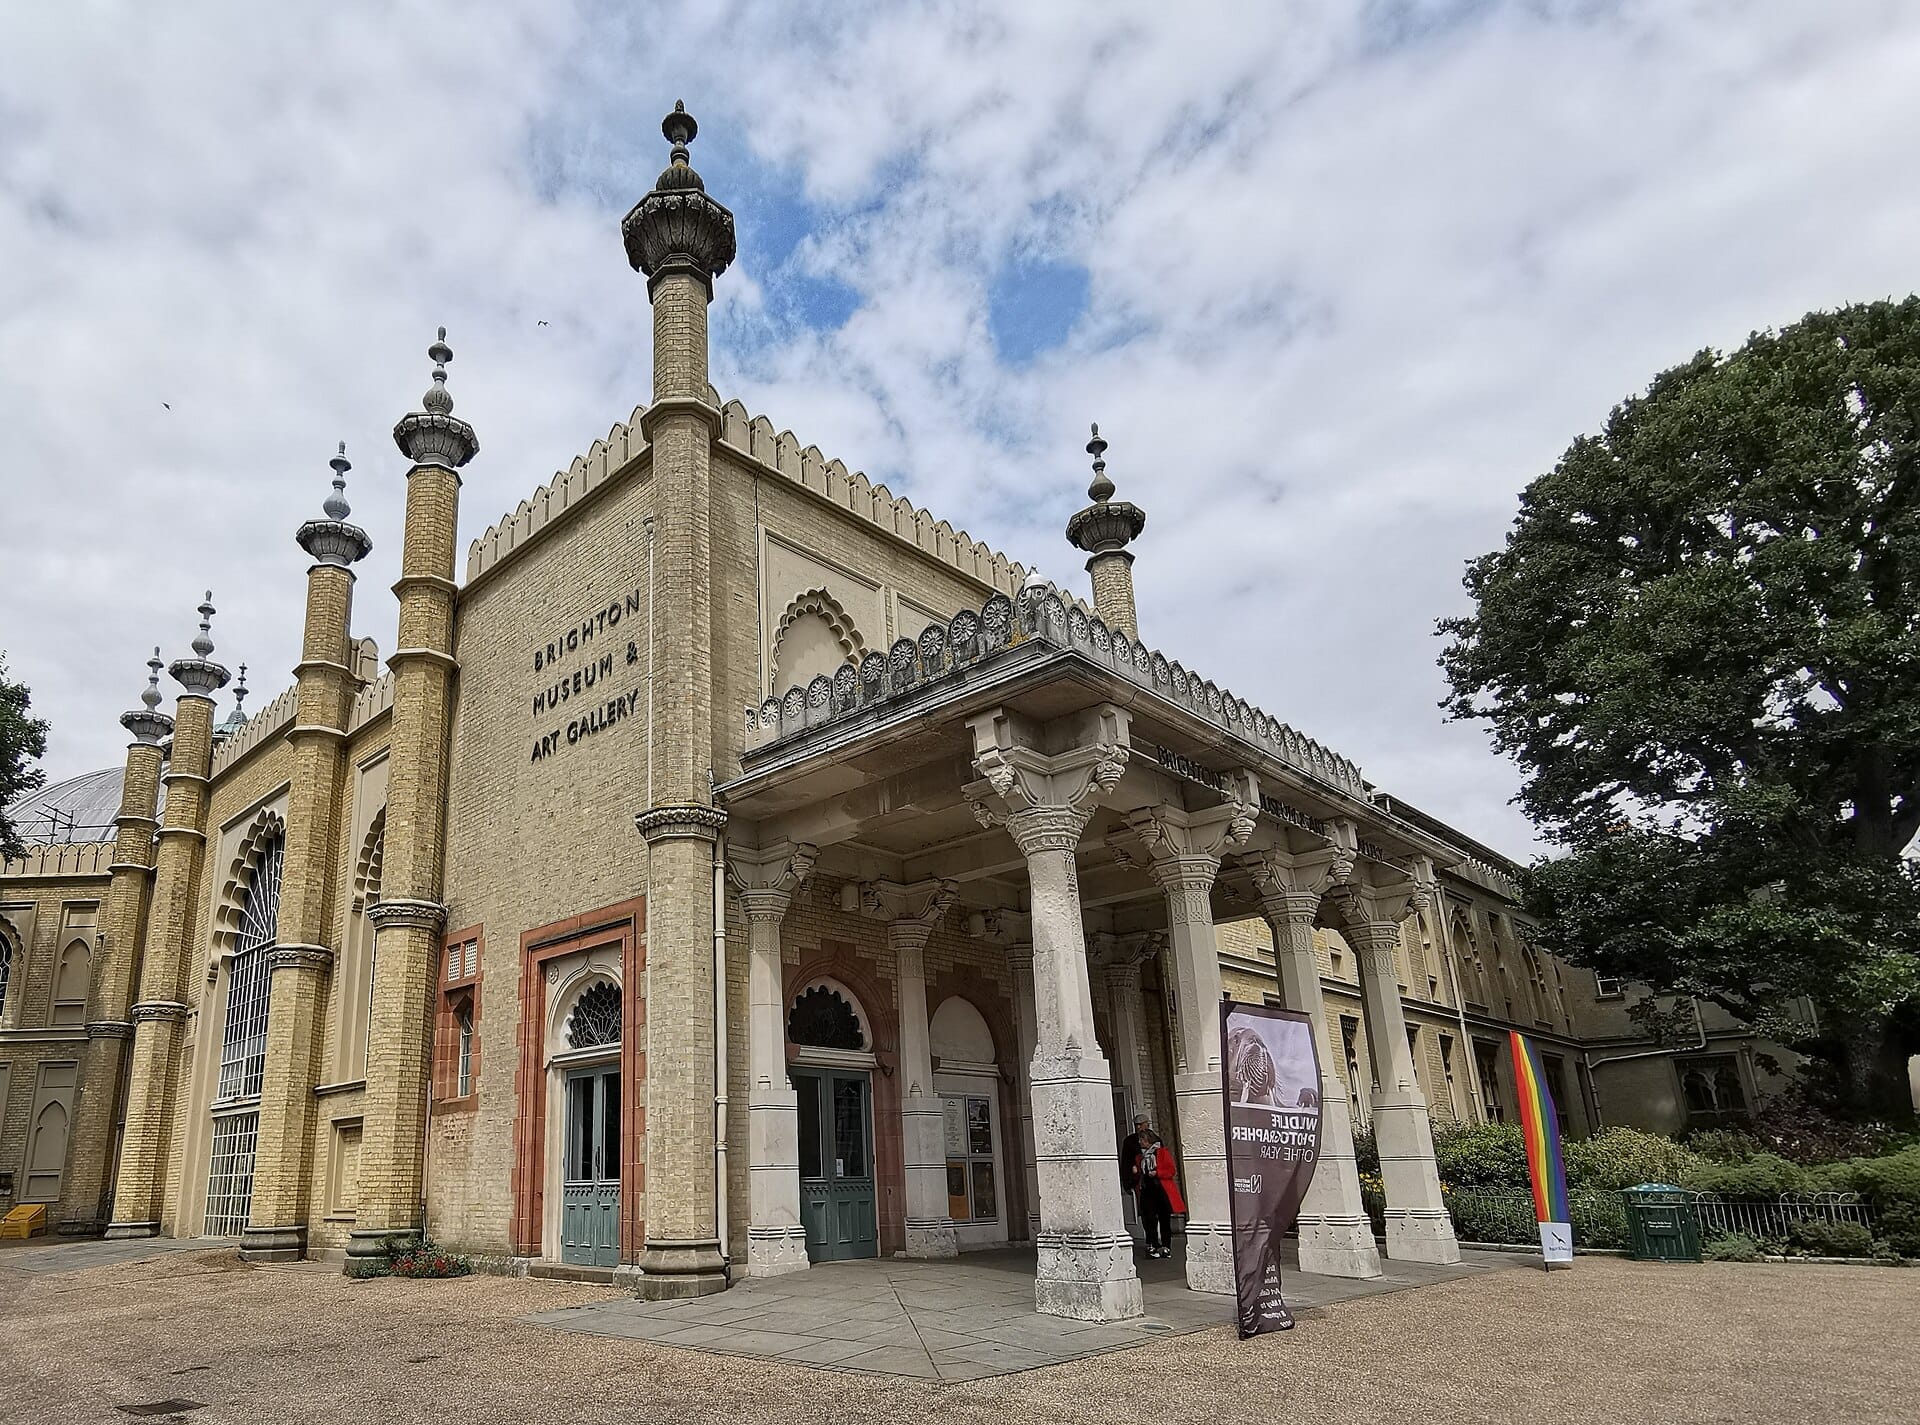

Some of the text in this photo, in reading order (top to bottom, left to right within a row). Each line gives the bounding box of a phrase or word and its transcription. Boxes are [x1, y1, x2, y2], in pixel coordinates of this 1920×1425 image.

[534, 589, 640, 672] BRIGHTON
[533, 641, 638, 718] MUSEUM &
[531, 688, 639, 765] ART GALLERY
[1157, 744, 1222, 790] BRIGHTON
